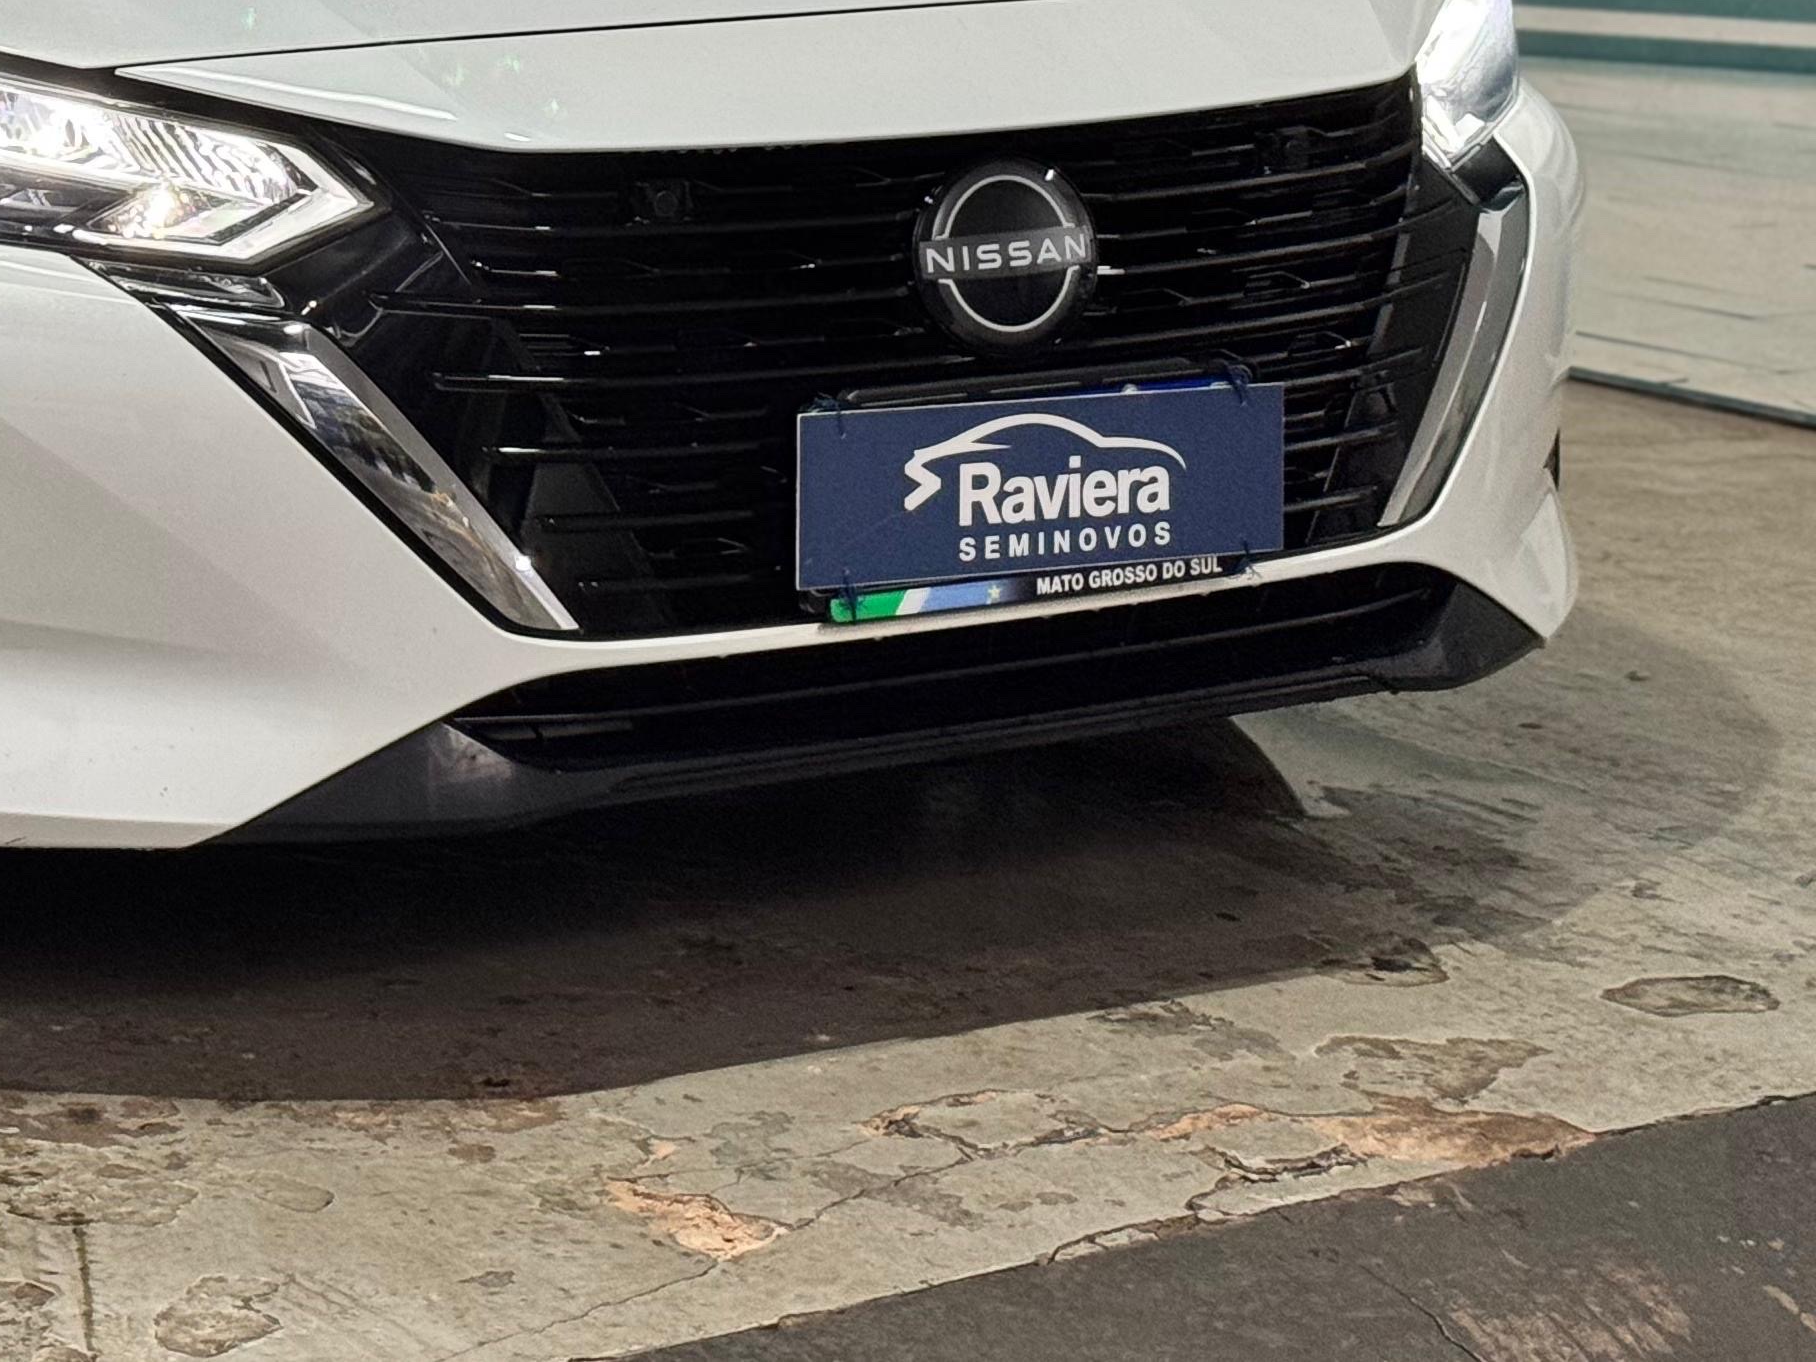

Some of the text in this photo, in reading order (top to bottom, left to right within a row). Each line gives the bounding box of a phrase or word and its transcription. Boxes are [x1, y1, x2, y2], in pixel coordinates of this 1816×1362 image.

[925, 233, 1086, 274] NISSAN
[957, 455, 1171, 527] Raviera
[958, 520, 1172, 562] SEMINOVOS
[1036, 555, 1223, 595] MATO GROSSO DO SUL
